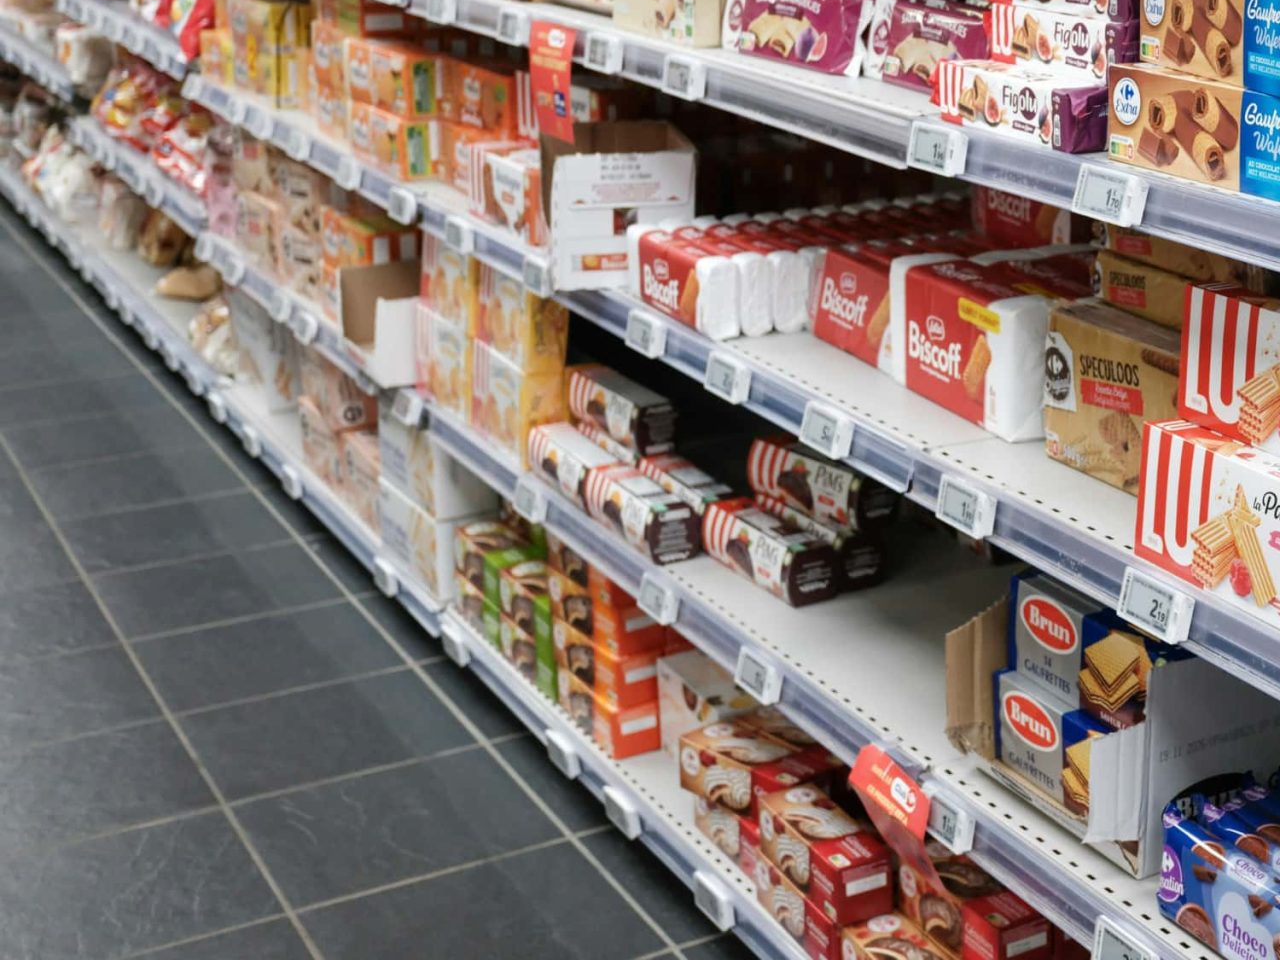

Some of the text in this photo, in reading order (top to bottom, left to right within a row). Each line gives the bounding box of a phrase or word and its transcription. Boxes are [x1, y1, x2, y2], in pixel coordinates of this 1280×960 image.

[1054, 22, 1090, 50] Figolu
[1002, 85, 1037, 114] Figolu
[1115, 99, 1138, 116] Extra
[643, 264, 679, 310] Biscoff
[1109, 271, 1146, 290] SPECULOOS
[821, 276, 869, 327] Biscoff
[909, 320, 962, 380] Biscoff
[1185, 286, 1251, 425] LU
[1080, 354, 1140, 387] SPECULOOS
[1141, 424, 1205, 567] LU
[1253, 497, 1262, 513] la
[1029, 604, 1071, 645] Brun
[1024, 659, 1071, 694] GAUFRETTES
[1011, 700, 1052, 743] Brun
[1009, 752, 1055, 788] GAUFRETTES
[1235, 858, 1265, 880] Choco
[1222, 913, 1267, 959] Choco
